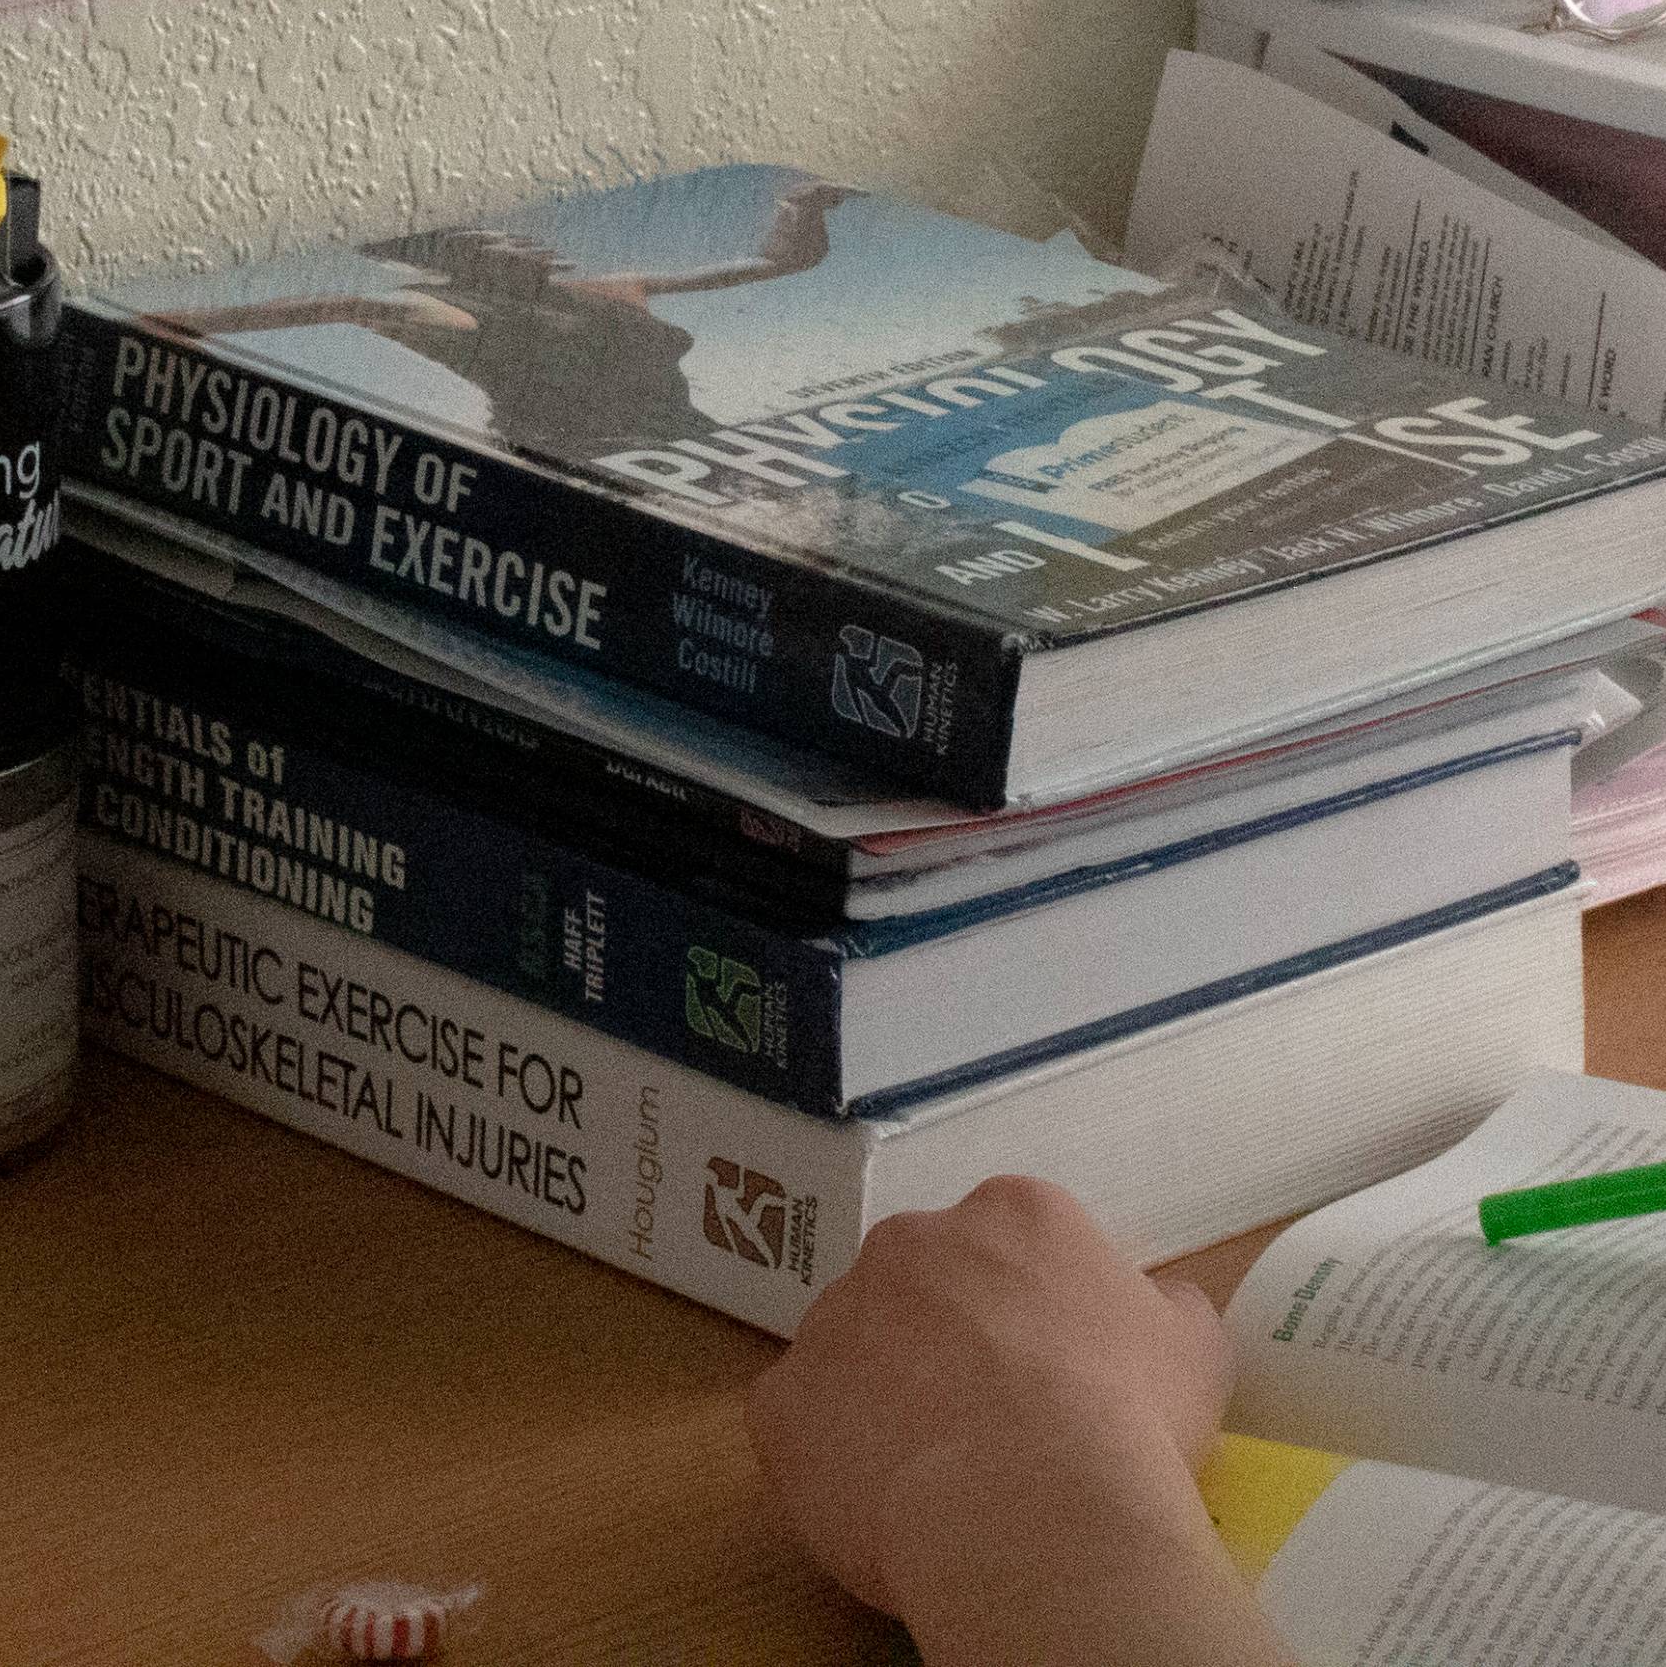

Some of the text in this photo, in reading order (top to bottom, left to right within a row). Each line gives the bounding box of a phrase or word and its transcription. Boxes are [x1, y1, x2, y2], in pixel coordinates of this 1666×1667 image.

[112, 336, 477, 513] PHYSIOLOGY OF
[100, 407, 608, 651] SPORT AND EXERCISE
[670, 589, 773, 658] Wilmore
[682, 552, 773, 618] Kenney
[677, 638, 758, 696] Costill
[247, 740, 285, 783] of
[94, 783, 374, 933] CONDITIONING
[220, 777, 407, 891] TRAINING
[563, 907, 583, 973] HAFF
[584, 890, 607, 1003] TRIPLETT
[298, 962, 583, 1130] EXERCISE FOR
[416, 1092, 587, 1216] INJURIES
[628, 1086, 660, 1260] Houglum
[787, 1198, 804, 1273] HUMAN
[799, 1196, 817, 1287] KINETICS
[1273, 1302, 1308, 1341] Bone
